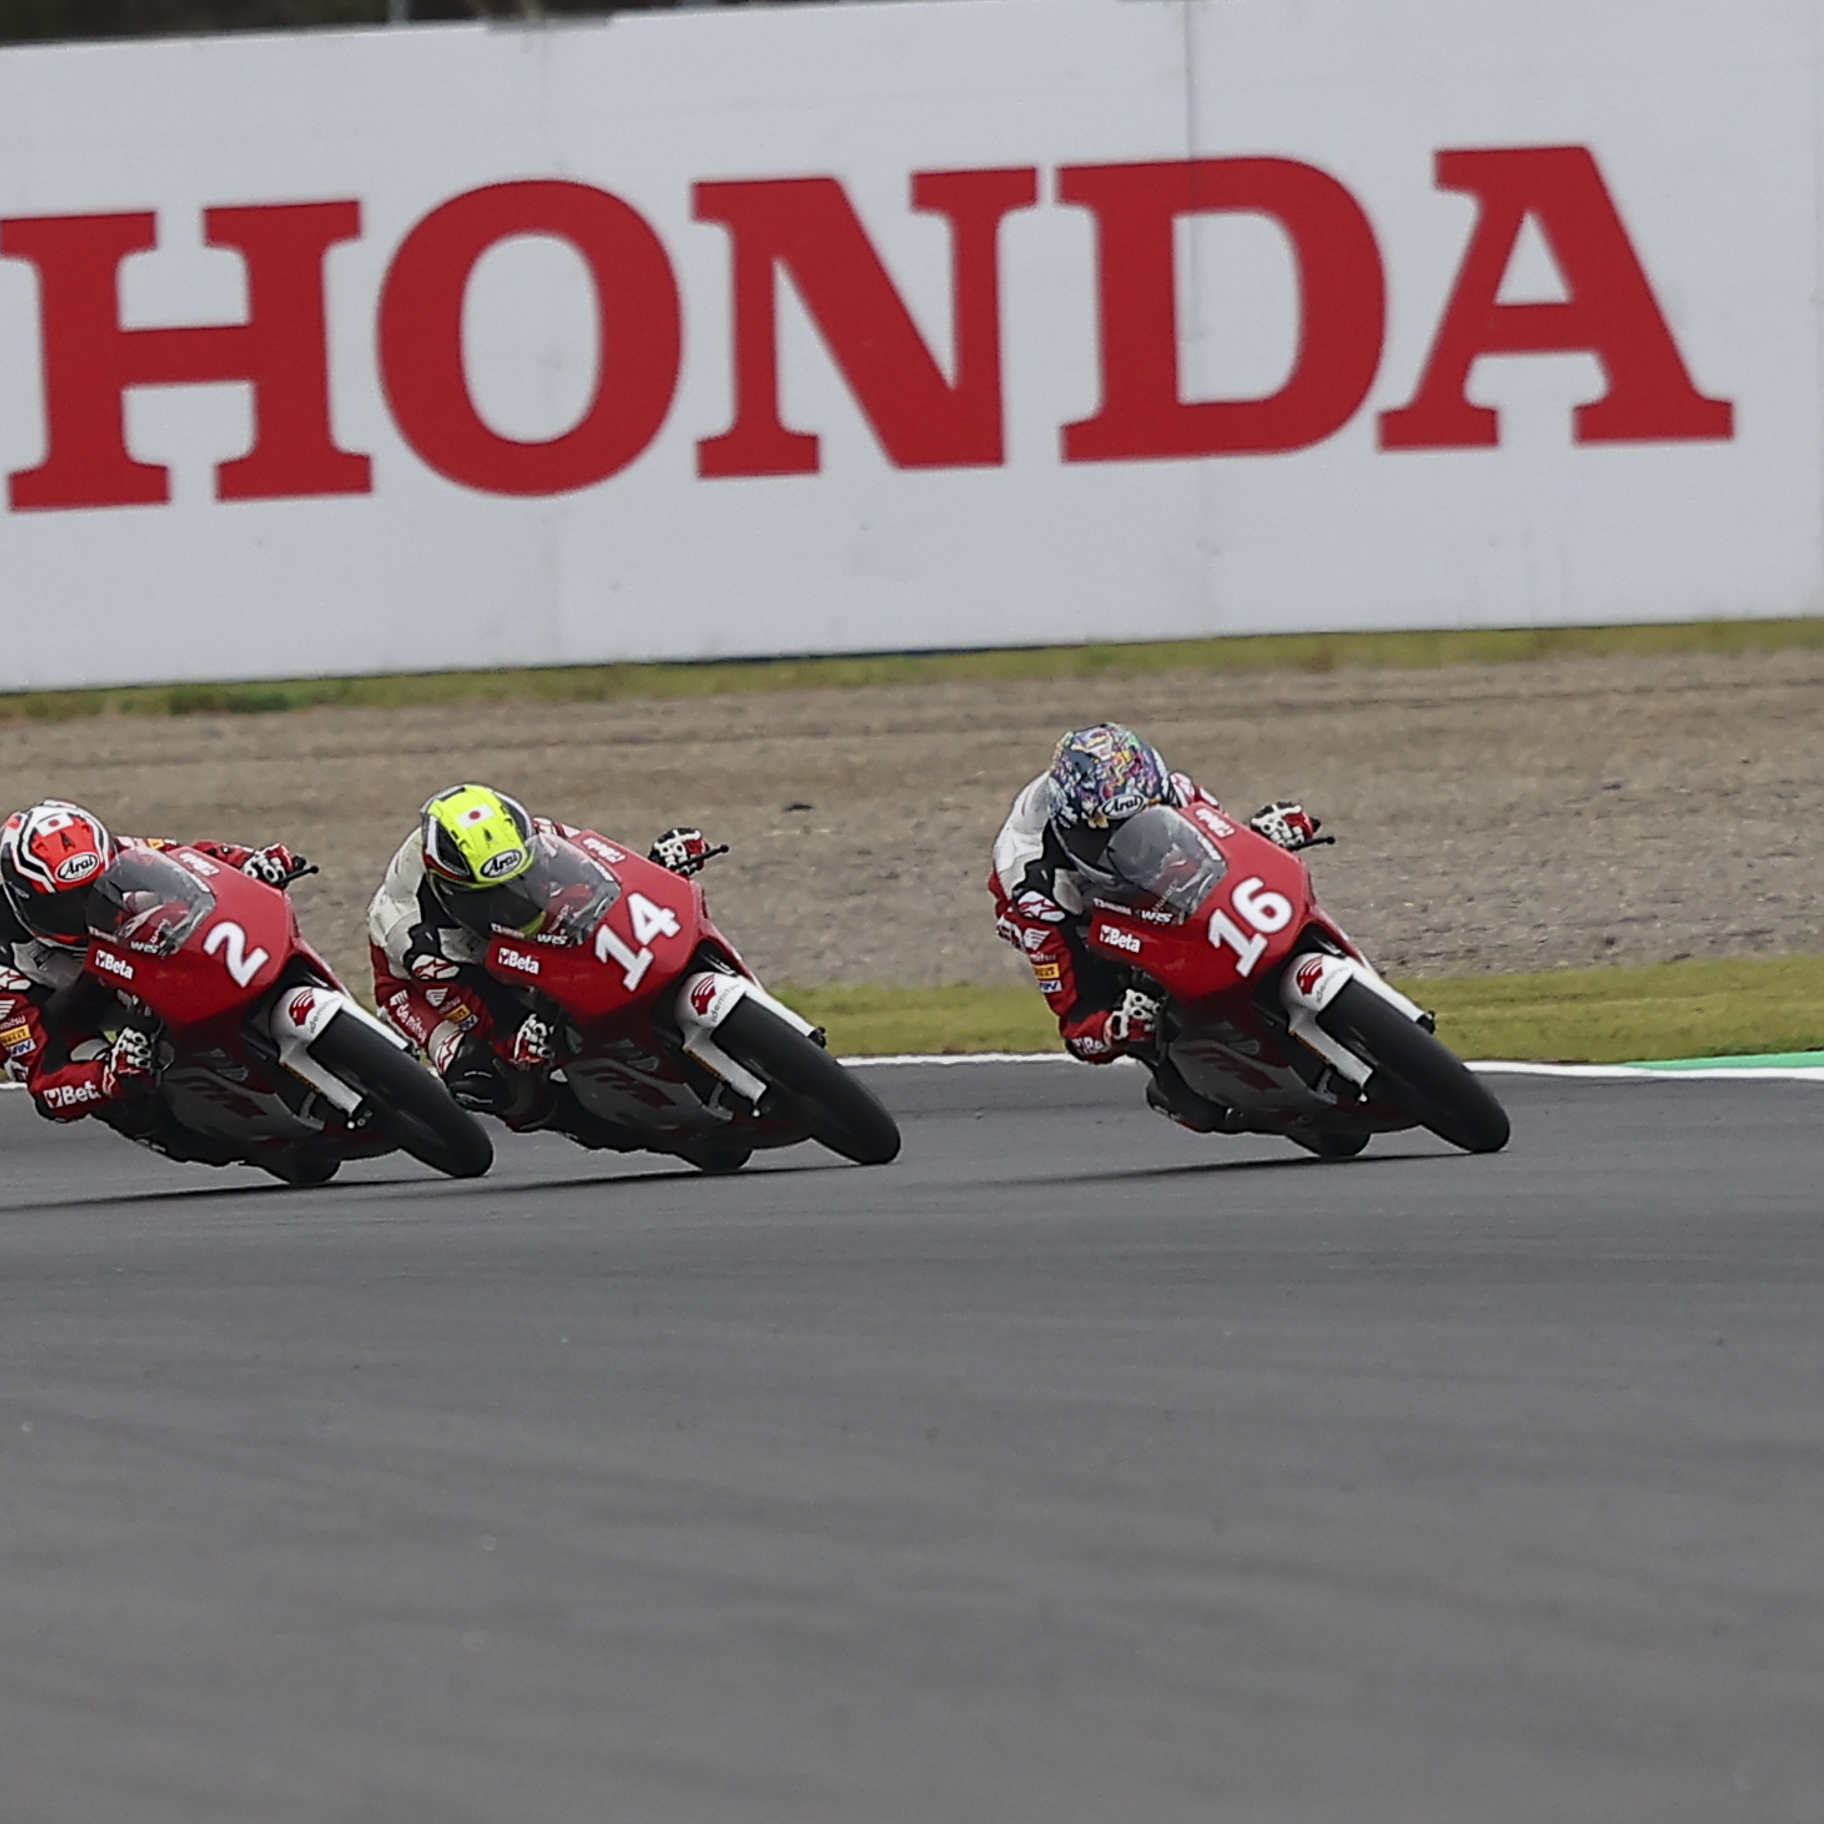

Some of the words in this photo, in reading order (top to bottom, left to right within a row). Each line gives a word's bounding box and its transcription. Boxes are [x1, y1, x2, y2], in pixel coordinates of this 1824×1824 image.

[0, 145, 1732, 510] HONDA
[1108, 796, 1138, 814] Arai
[66, 855, 95, 875] Arai
[489, 854, 517, 873] Arai
[1208, 877, 1294, 977] 16
[594, 892, 681, 992] 14
[1110, 928, 1141, 953] Beta
[105, 954, 133, 979] Beta
[204, 921, 269, 988] 2
[510, 950, 539, 974] Beta
